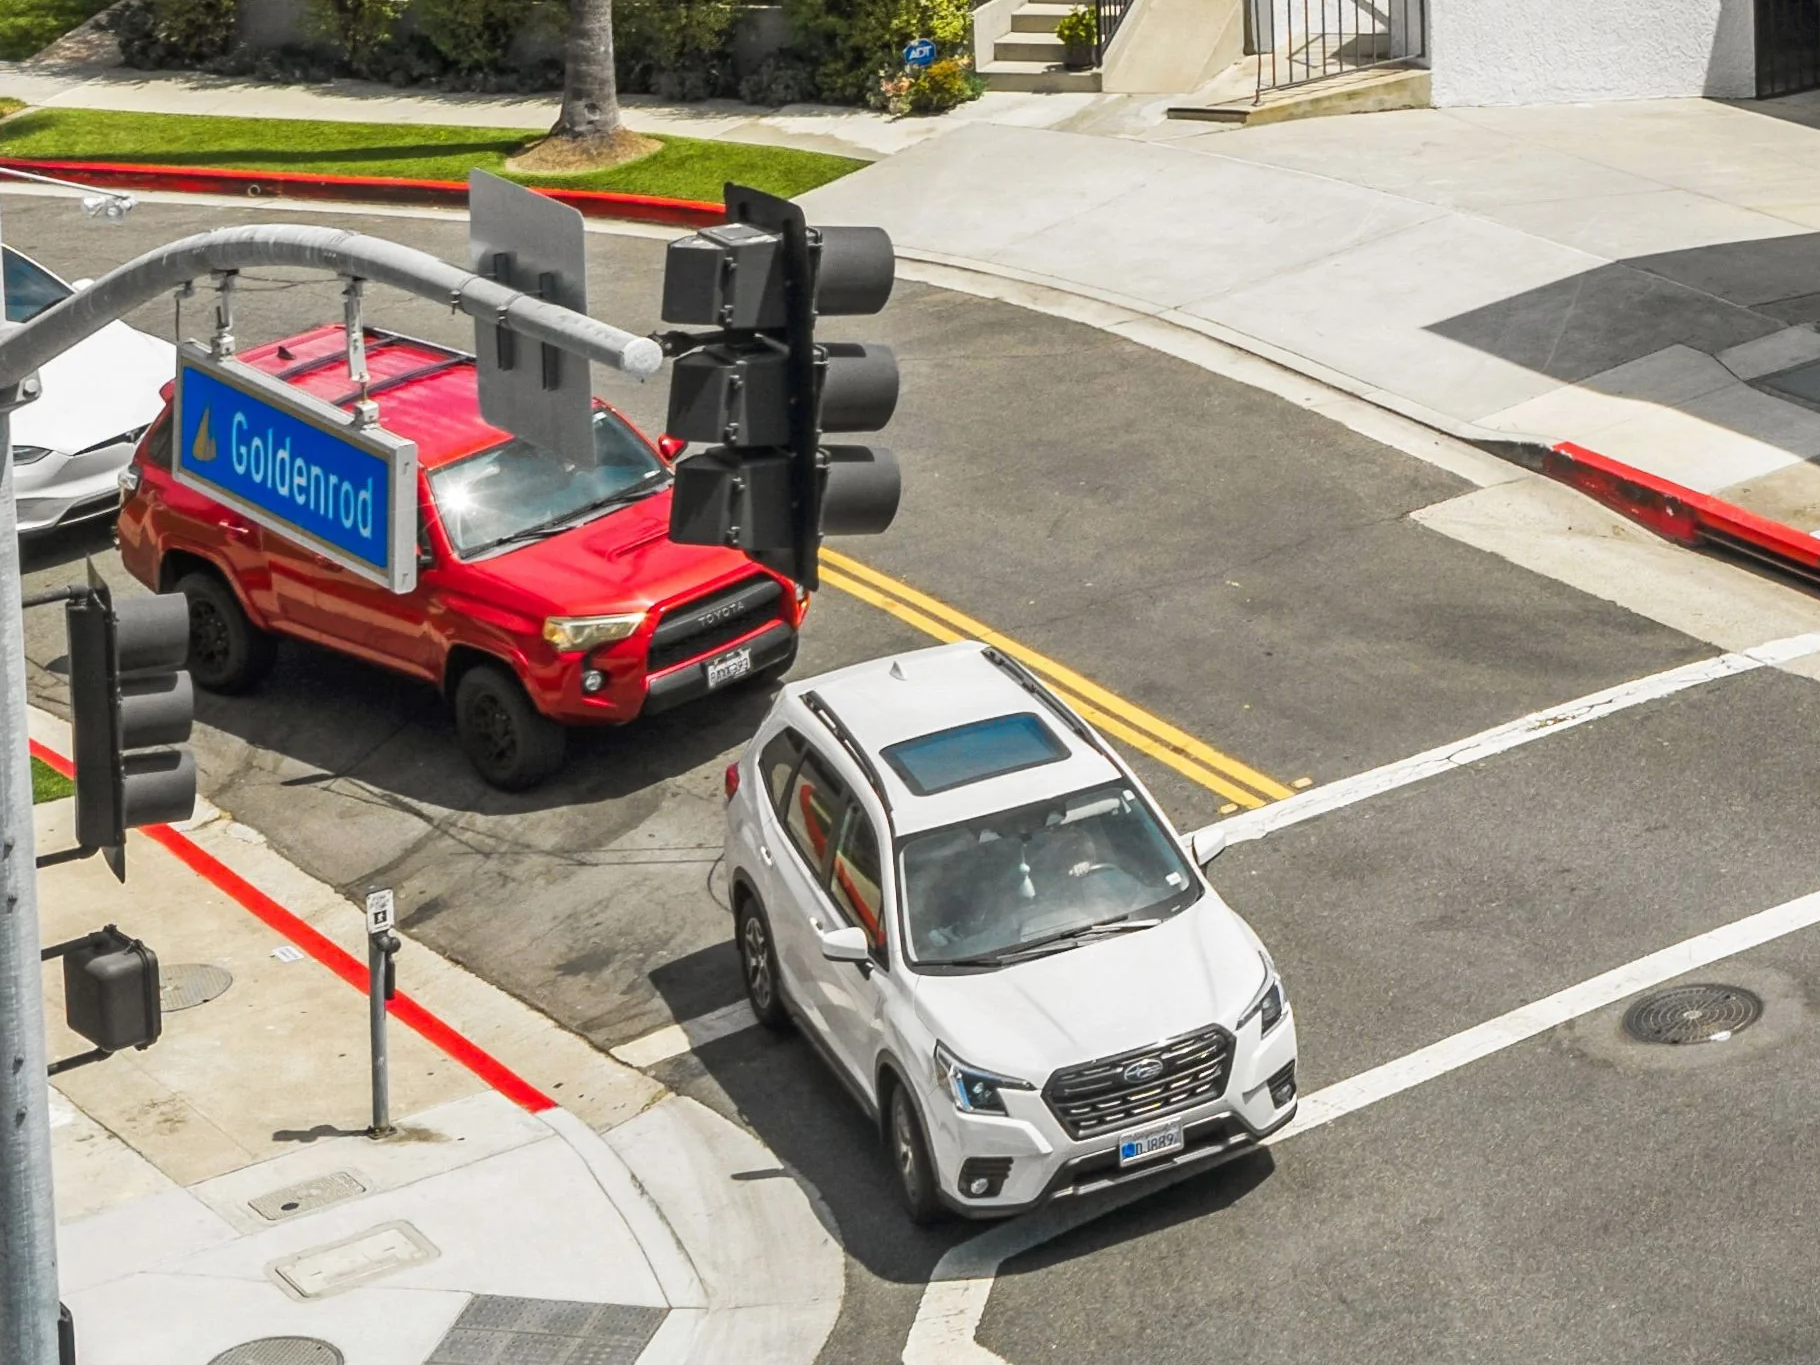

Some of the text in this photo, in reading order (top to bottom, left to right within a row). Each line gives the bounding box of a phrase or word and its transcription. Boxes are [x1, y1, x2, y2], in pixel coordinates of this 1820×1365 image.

[908, 45, 932, 60] ADT
[232, 411, 373, 539] Goldenrod
[698, 601, 744, 626] TOYOTA
